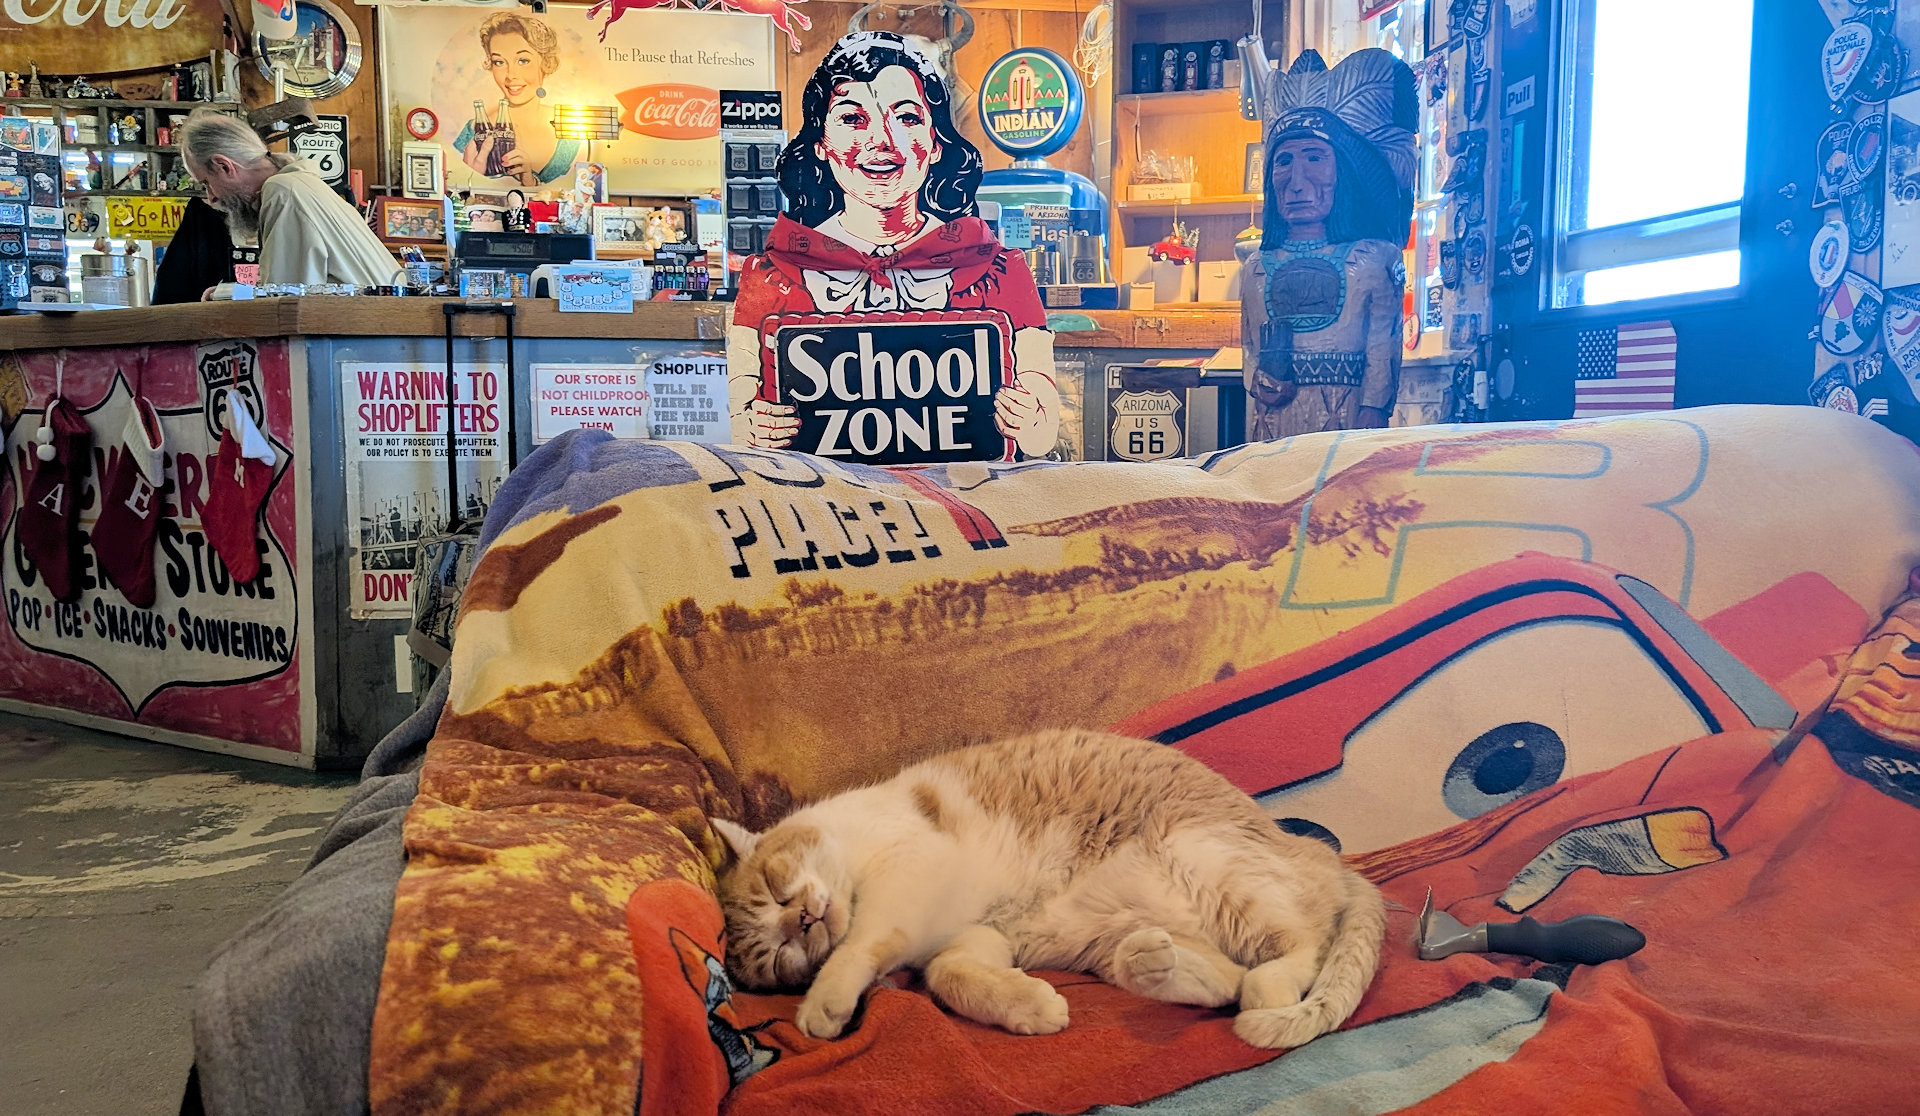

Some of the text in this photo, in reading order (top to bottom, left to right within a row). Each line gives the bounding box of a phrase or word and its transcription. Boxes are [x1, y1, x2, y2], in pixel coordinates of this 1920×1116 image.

[1834, 32, 1859, 45] POLICE
[1828, 38, 1866, 55] NATIONALE
[605, 47, 755, 67] The Pause that Refreshes
[659, 90, 684, 99] DRINK
[1508, 86, 1530, 108] Pull
[634, 97, 719, 128] Coca-Cola
[994, 109, 1054, 133] INDIAN
[1003, 130, 1045, 140] GASOLINE
[1828, 128, 1851, 140] POLICE
[302, 139, 335, 147] ROUTE
[622, 157, 648, 166] SIGN
[653, 158, 666, 166] OF
[671, 158, 703, 167] GOOD
[161, 204, 186, 228] AM
[3, 243, 19, 252] 66
[236, 265, 254, 273] NOT
[1077, 268, 1094, 280] 66
[591, 276, 603, 284] 66
[207, 356, 247, 380] ROUE
[654, 363, 728, 376] SHOPLIFT
[788, 329, 991, 401] School
[555, 374, 637, 385] OUR STORE IS
[467, 372, 498, 401] TO
[654, 383, 707, 395] WILL BE
[542, 390, 568, 400] NOT
[654, 398, 714, 408] TAKEN TO
[1122, 399, 1171, 411] ARIZONA
[551, 406, 642, 416] PLEASE WATCH
[654, 411, 719, 422] THE TRAIN
[358, 403, 500, 433] SHOPLIFERS
[654, 425, 705, 436] STATION
[814, 406, 972, 456] ZONE
[359, 438, 500, 447] WE DO NOT PROSECUTE OPLIFTERS,
[1129, 431, 1164, 454] 66
[366, 448, 492, 457] OUR POLICY IS TO EXEUTE THEM
[38, 483, 65, 516] A
[124, 472, 154, 520] E
[704, 496, 943, 579] PLACE!
[159, 517, 276, 600] STOE
[364, 573, 413, 602] DON'
[10, 588, 289, 663] POP ICE SNACKS SOUVENIRS
